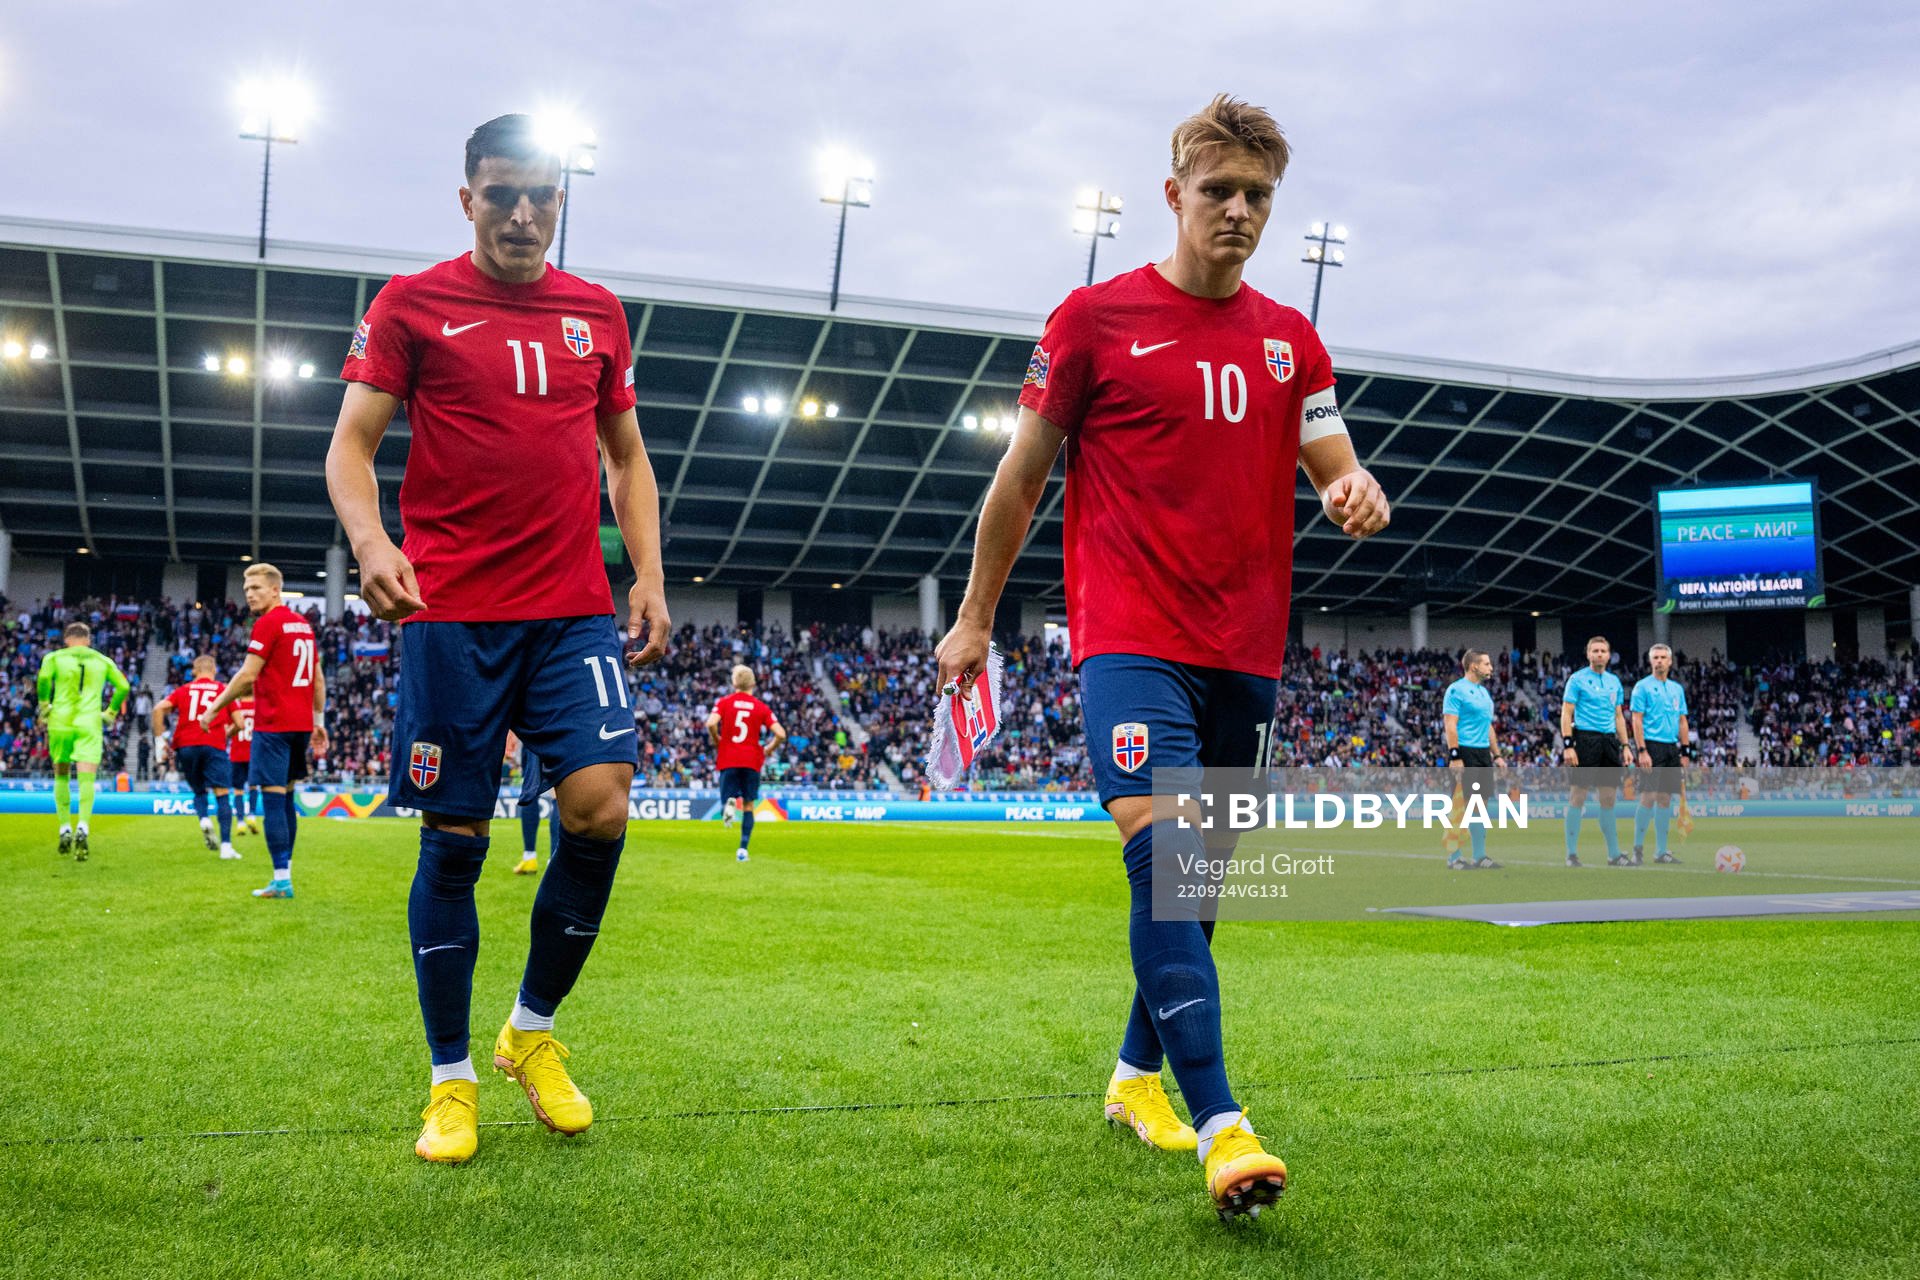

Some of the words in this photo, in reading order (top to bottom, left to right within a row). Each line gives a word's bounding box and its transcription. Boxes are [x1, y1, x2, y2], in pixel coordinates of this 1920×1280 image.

[506, 340, 547, 395] 11
[1196, 361, 1247, 423] 10
[1678, 524, 1734, 542] PEACE
[1679, 582, 1707, 594] UEFA
[1708, 580, 1758, 593] NATIONS
[1760, 578, 1803, 591] LEAGUE
[292, 638, 314, 687] 21
[78, 664, 85, 692] 1
[584, 656, 627, 708] 11
[189, 690, 217, 721] 15
[732, 710, 750, 743] 5
[153, 799, 196, 814] PEAC
[801, 806, 843, 819] PEACE
[1005, 807, 1044, 820] PEACE
[1846, 803, 1878, 816] PEACE
